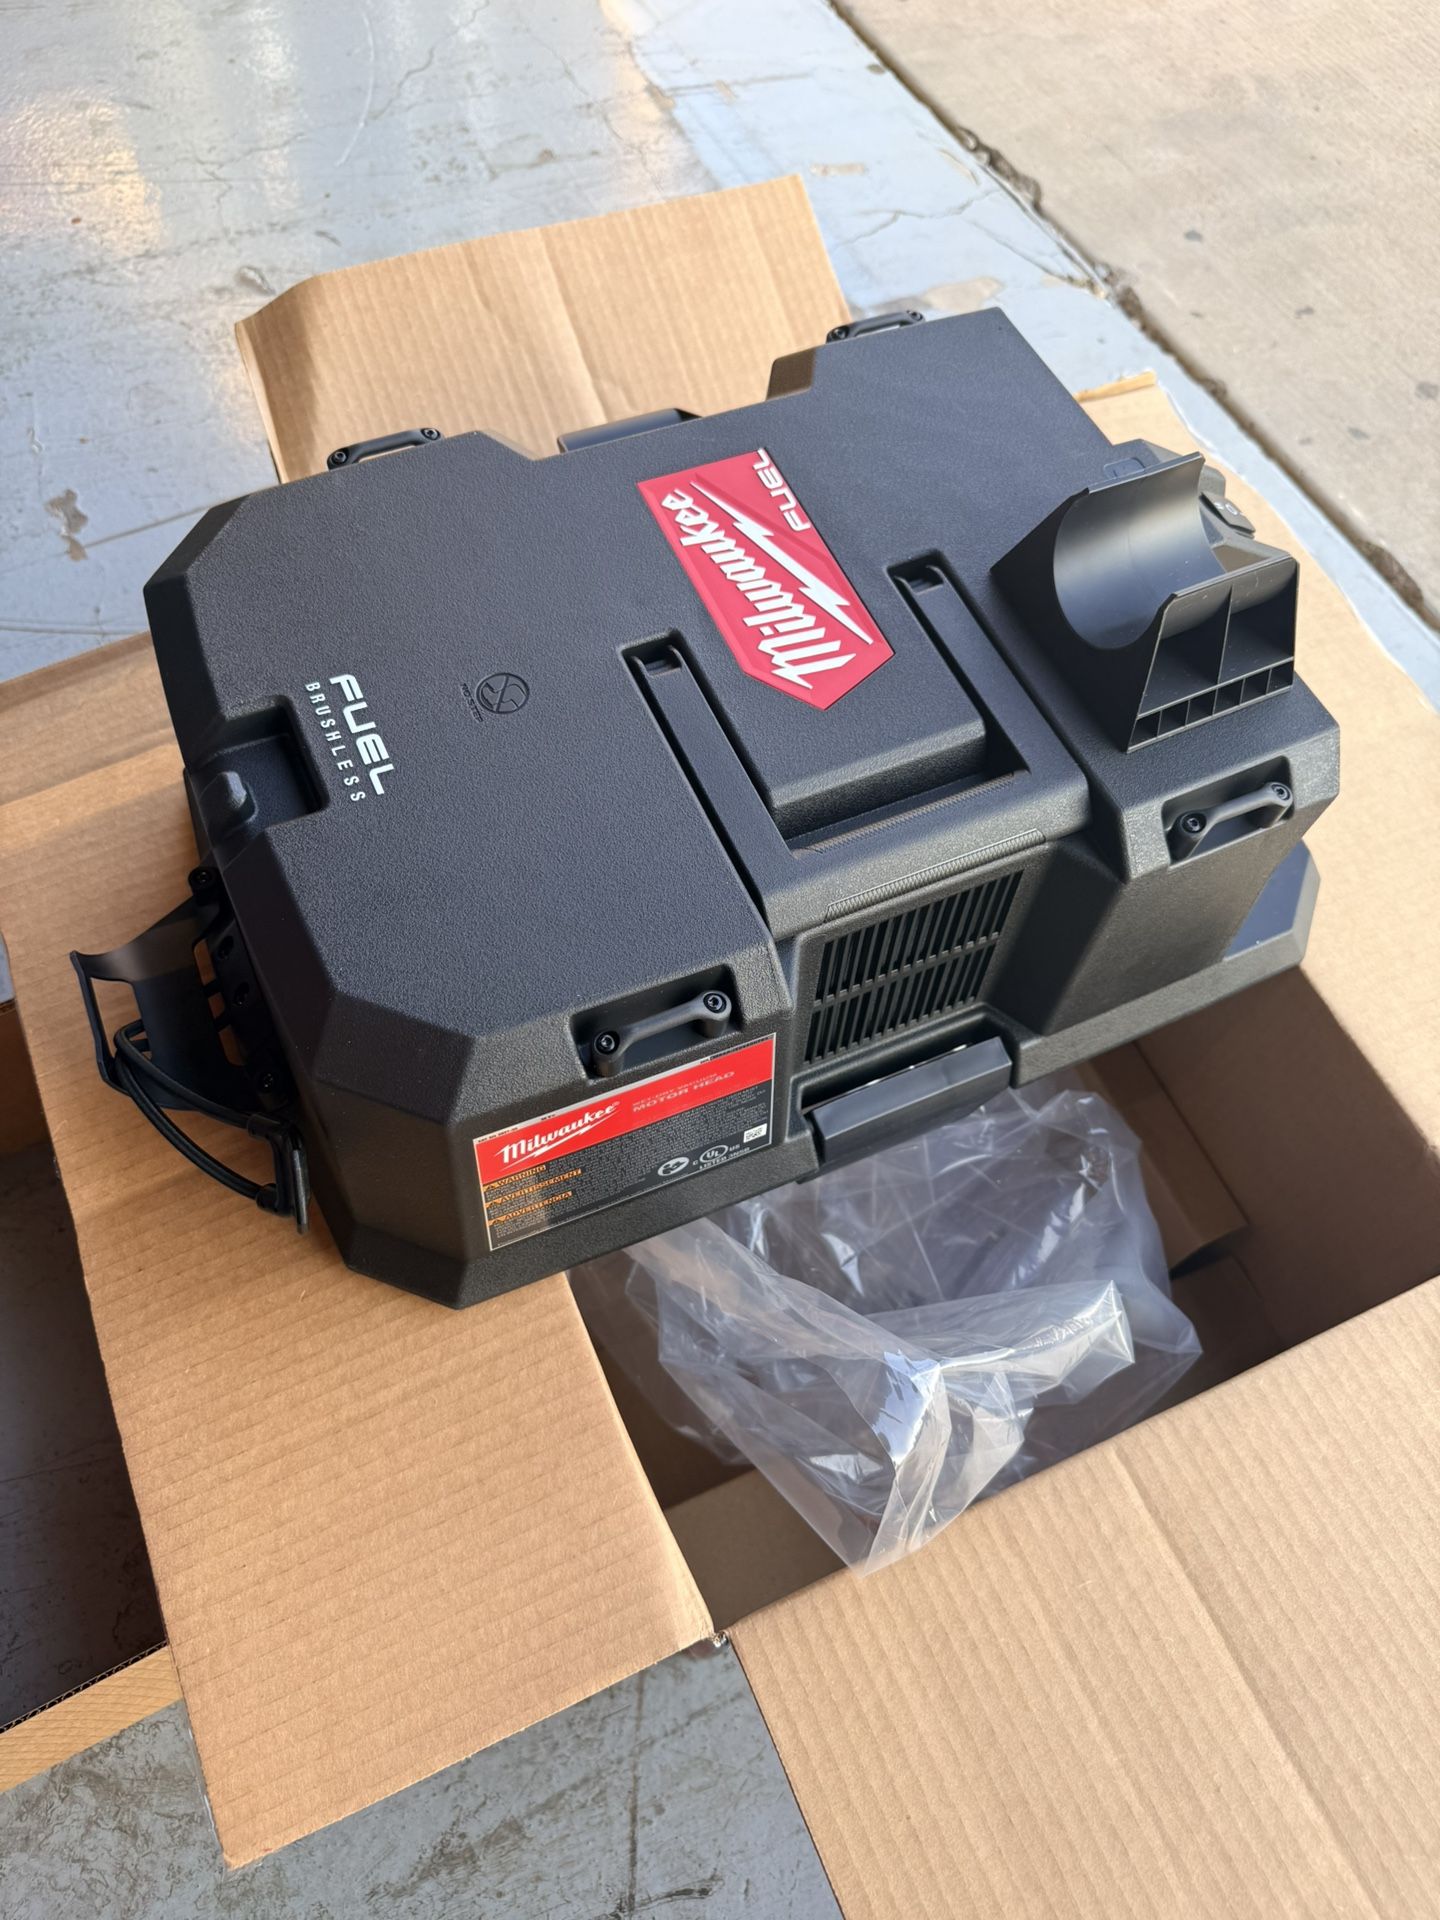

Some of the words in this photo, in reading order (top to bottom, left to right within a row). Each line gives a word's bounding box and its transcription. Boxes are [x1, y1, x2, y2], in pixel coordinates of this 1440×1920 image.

[753, 448, 811, 532] FUEL
[661, 489, 856, 690] Milwaukee
[304, 681, 366, 802] BRUSHLESS
[329, 674, 395, 796] FUEL
[632, 1088, 689, 1113] MOTOR
[693, 1070, 735, 1091] HEAD
[493, 1103, 618, 1164] Milwaukee
[706, 1149, 720, 1159] UL
[498, 1165, 546, 1186] WARNING
